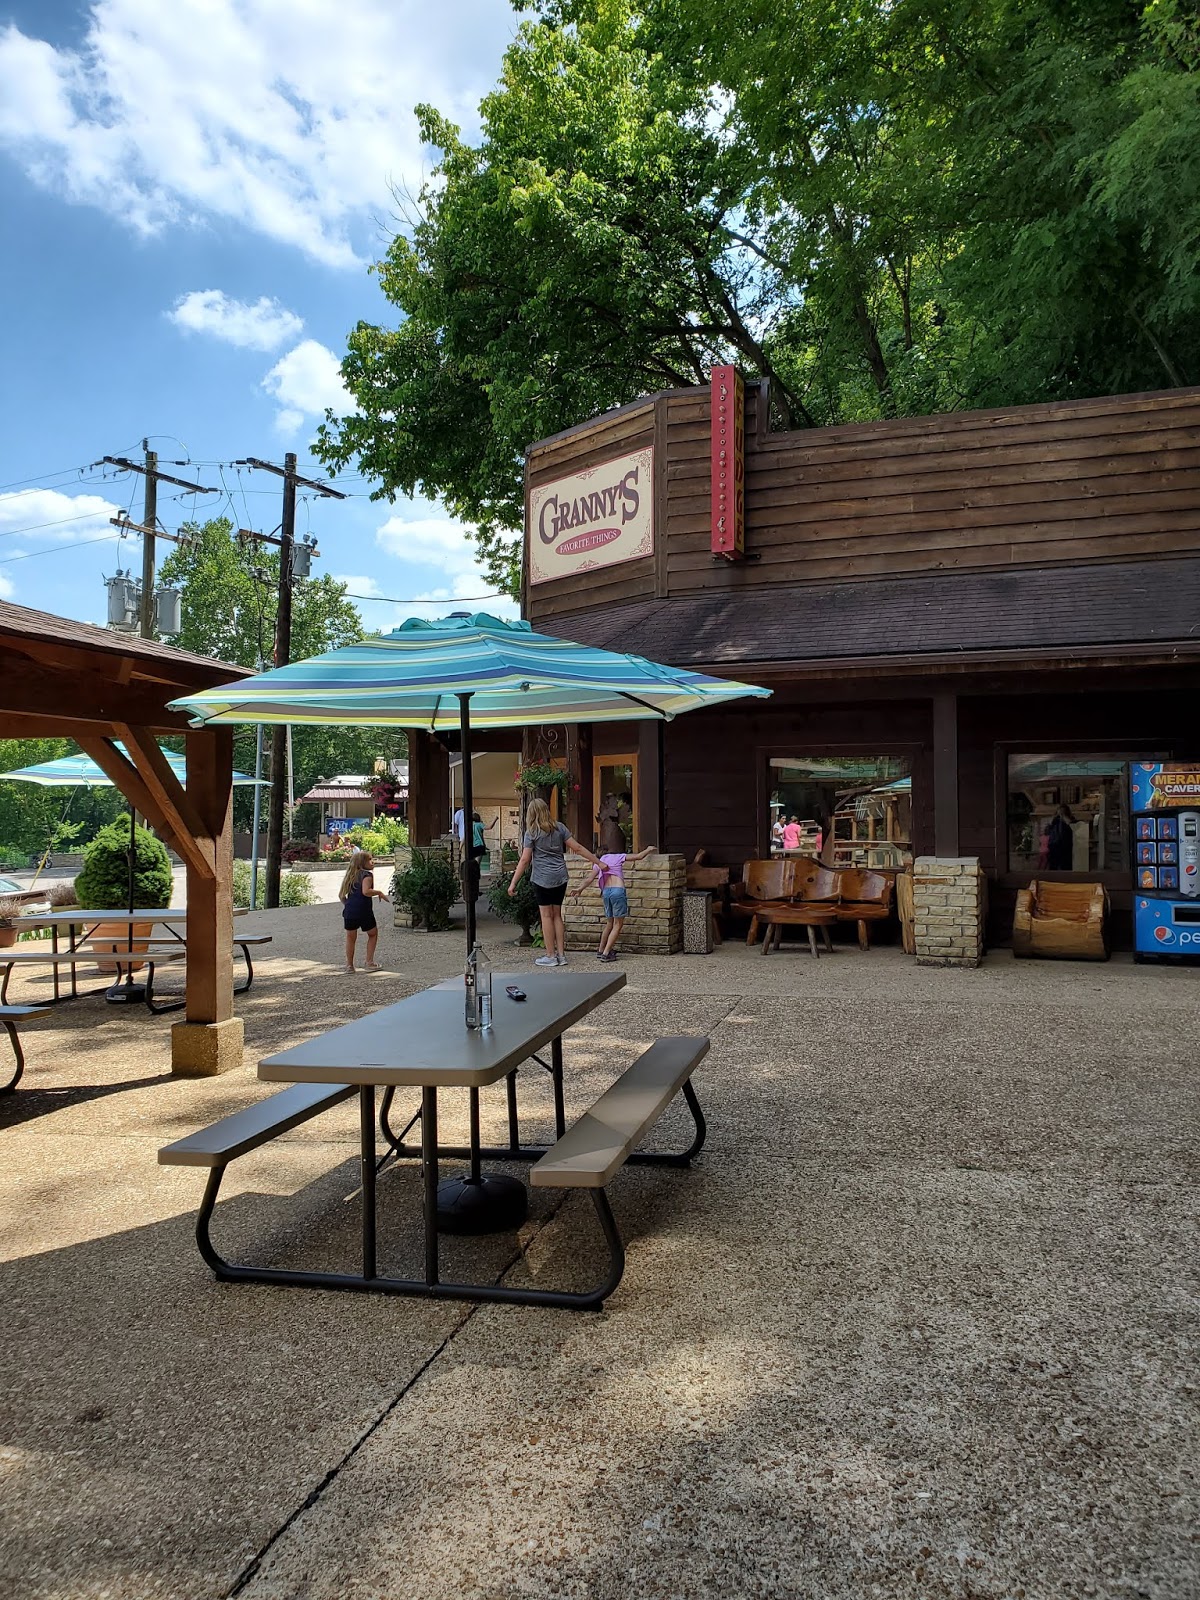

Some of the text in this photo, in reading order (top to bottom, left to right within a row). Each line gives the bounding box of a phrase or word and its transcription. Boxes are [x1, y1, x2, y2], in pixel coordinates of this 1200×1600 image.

[539, 465, 640, 545] GRANNY'S
[735, 396, 743, 544] FUDGE
[560, 529, 617, 553] FAVORITE THINGS
